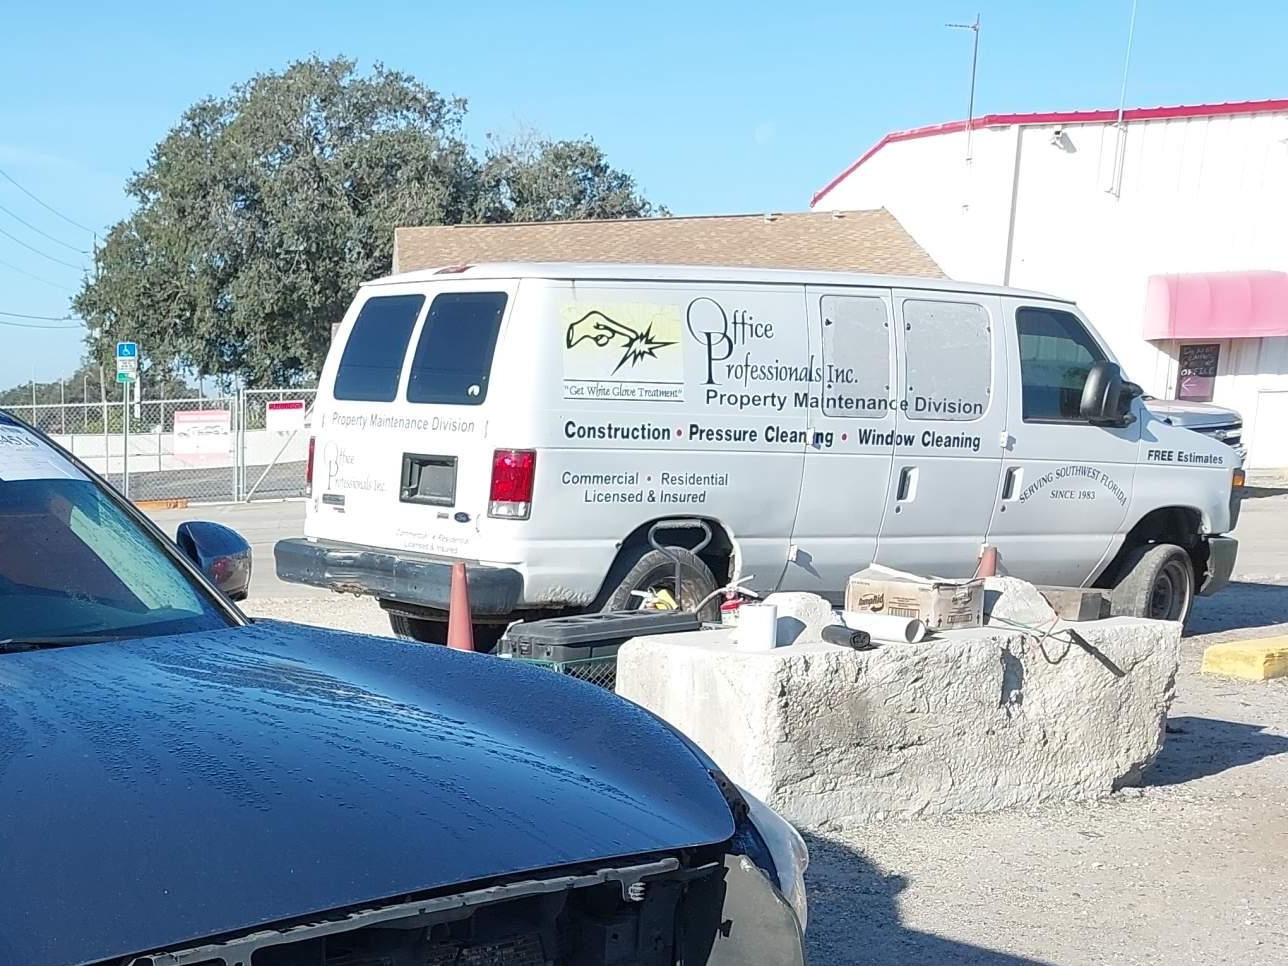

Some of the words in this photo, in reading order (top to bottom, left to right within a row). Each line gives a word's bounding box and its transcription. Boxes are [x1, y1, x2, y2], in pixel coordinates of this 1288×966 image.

[686, 296, 774, 345] Office
[700, 331, 822, 387] Professionals
[827, 364, 858, 384] Inc.
[612, 384, 636, 397] Glove
[706, 389, 787, 412] Property
[794, 393, 908, 412] Maintenance
[915, 396, 983, 415] Division
[331, 412, 367, 430] Property
[370, 414, 428, 431] Maintenance
[432, 417, 475, 433] Division
[564, 420, 671, 441] Construction
[689, 424, 758, 442] Pressure
[764, 426, 834, 448] Cleanng
[858, 428, 915, 447] Window
[921, 431, 981, 452] Cleaning
[1147, 449, 1173, 461] FREE
[1177, 451, 1224, 464] Estimates
[562, 471, 639, 485] Commercial
[661, 472, 728, 486] Residential
[1019, 473, 1054, 504] SERVING
[1055, 465, 1100, 481] SOUTHWEST
[1100, 474, 1128, 507] FLORIDA
[584, 489, 643, 503] Licensed
[647, 489, 656, 503] &
[660, 490, 706, 504] Insured
[1050, 490, 1076, 499] SINCE
[1078, 490, 1096, 500] 1983
